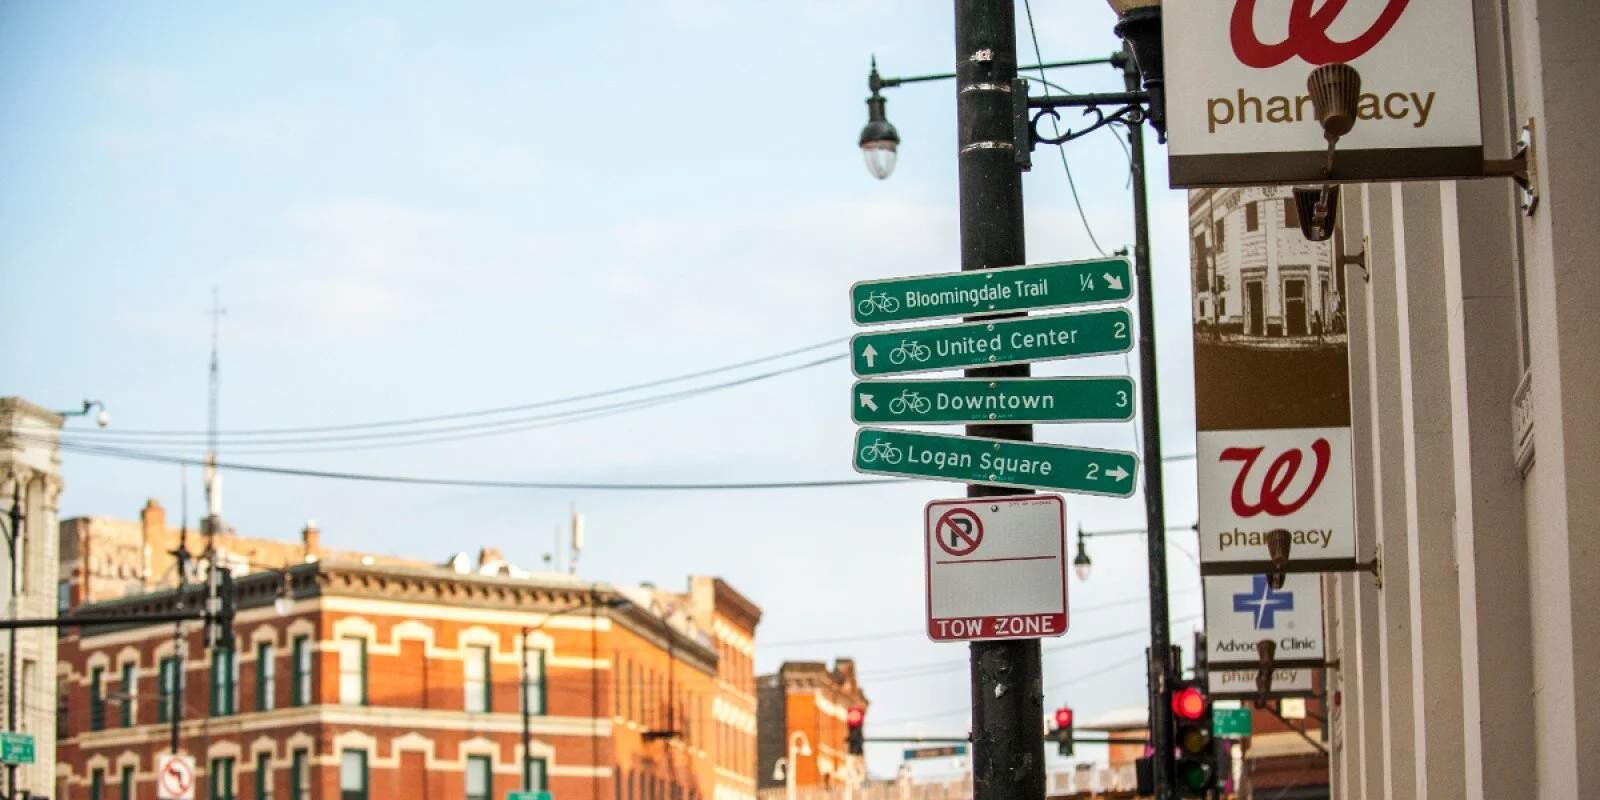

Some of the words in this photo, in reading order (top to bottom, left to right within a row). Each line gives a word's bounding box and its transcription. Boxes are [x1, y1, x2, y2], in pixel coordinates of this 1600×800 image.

[1207, 88, 1436, 134] pharacy
[905, 284, 1011, 308] Bloomingdale
[1015, 279, 1049, 297] Trail
[936, 334, 1001, 357] United
[1010, 328, 1078, 349] Center
[1113, 322, 1126, 339] 2
[936, 392, 1055, 410] Downtown
[1115, 390, 1128, 408] 3
[908, 446, 972, 470] Logan
[979, 452, 1052, 476] Square
[1086, 463, 1100, 480] 2
[1219, 527, 1333, 551] pharacy
[937, 620, 983, 637] TOW
[995, 616, 1055, 635] ZONE
[1280, 636, 1316, 651] Clinic
